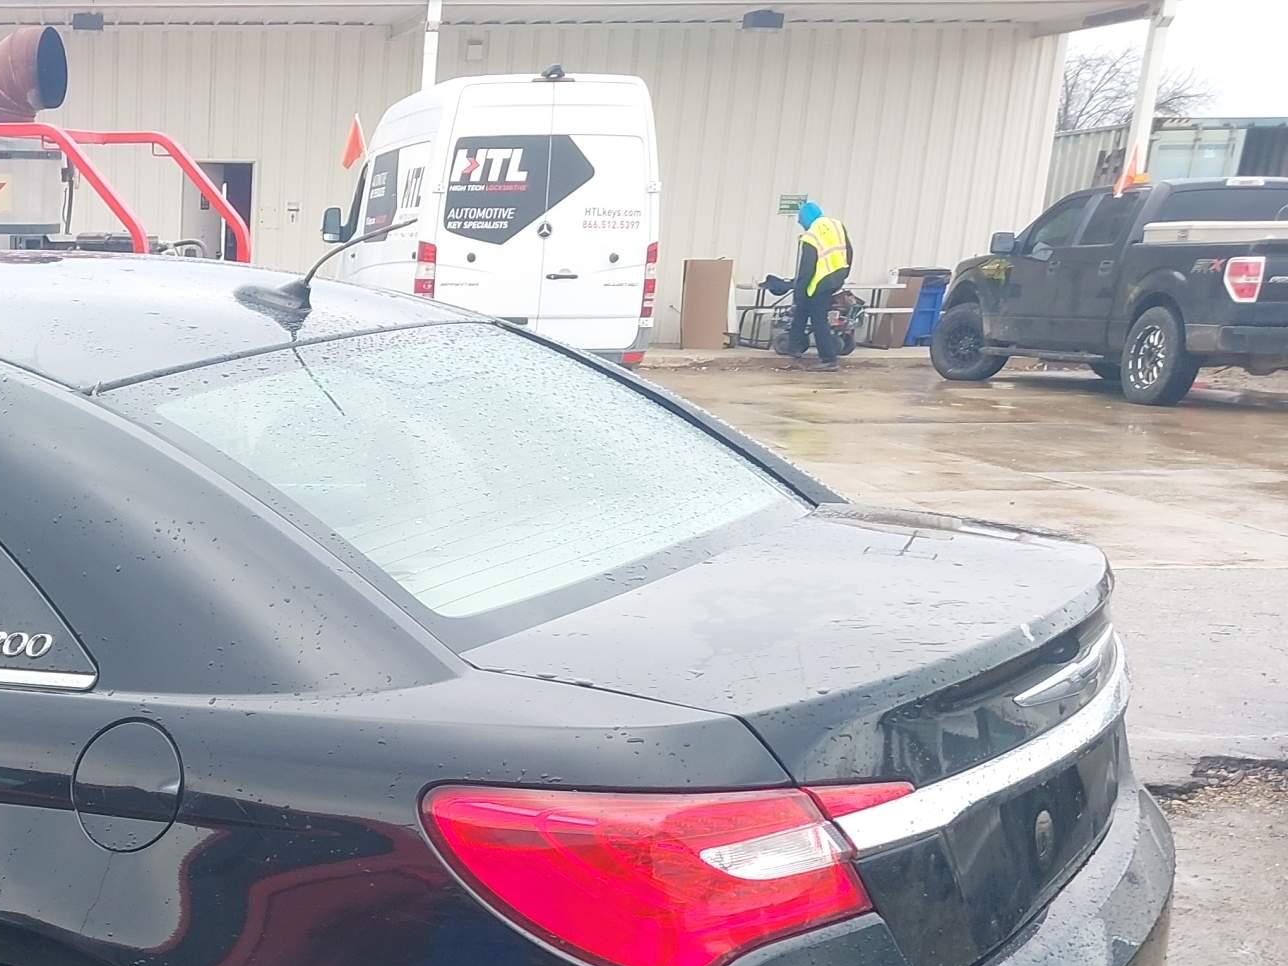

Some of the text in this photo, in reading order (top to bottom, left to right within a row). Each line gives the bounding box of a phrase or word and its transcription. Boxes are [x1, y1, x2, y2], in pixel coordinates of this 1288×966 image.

[450, 148, 528, 182] HTL
[449, 184, 466, 192] HIGH
[467, 184, 485, 192] TECH
[447, 207, 516, 219] AUTOMOTIVE
[584, 207, 642, 219] HTLkeys.com
[447, 221, 509, 229] KEY SPECIALISTS
